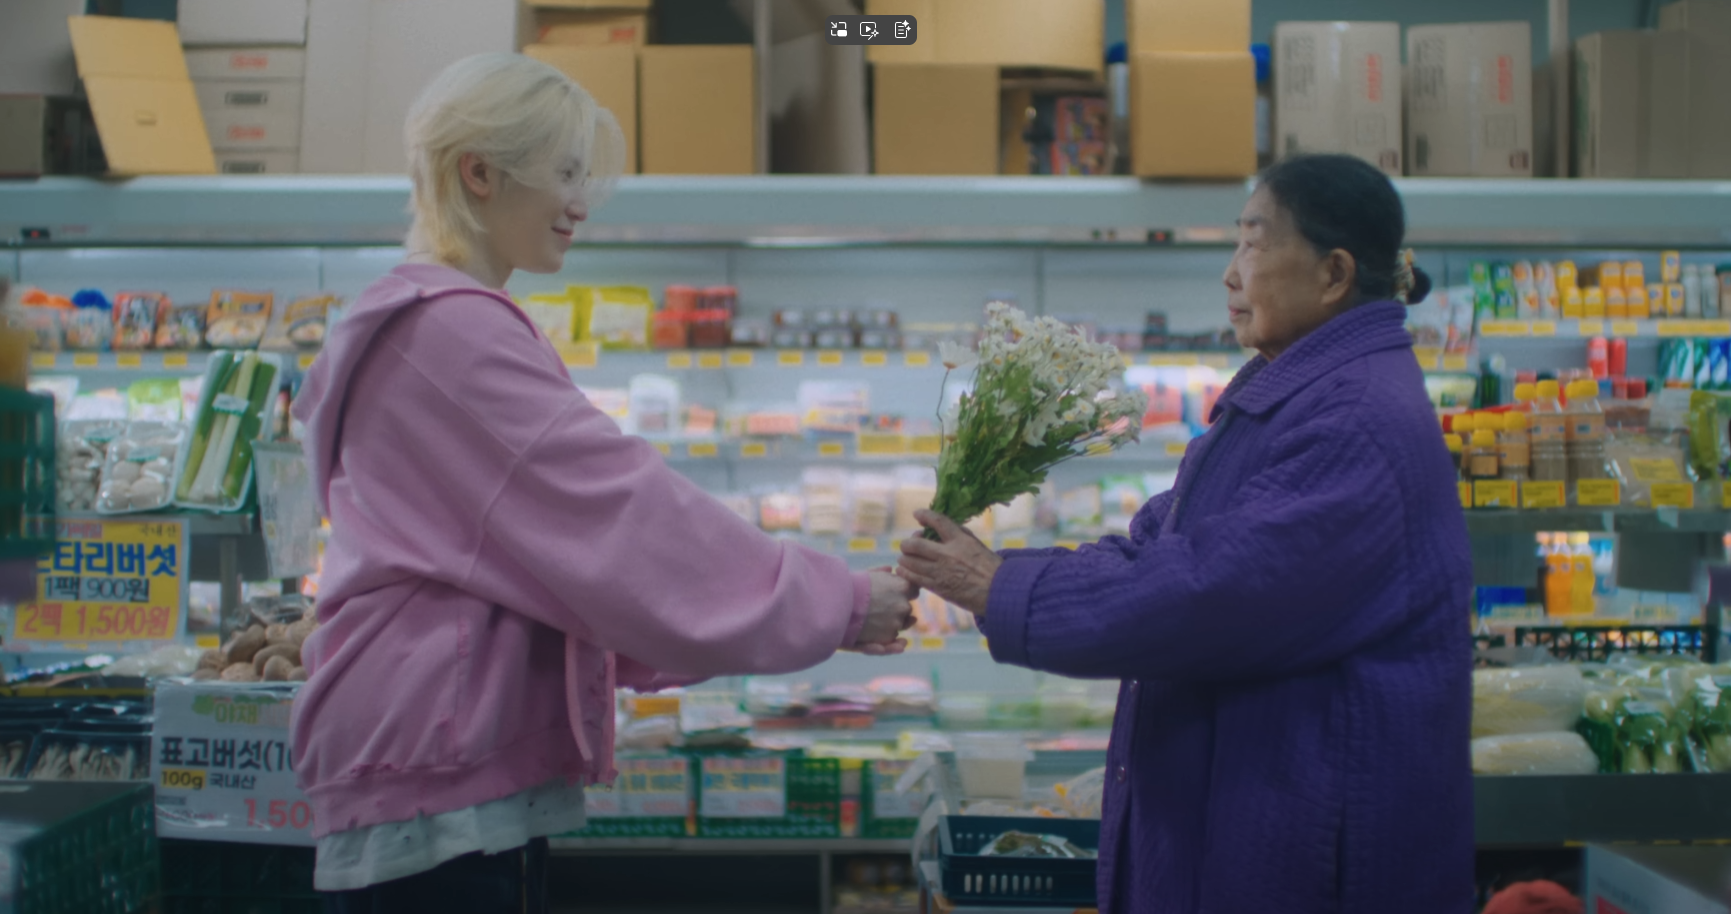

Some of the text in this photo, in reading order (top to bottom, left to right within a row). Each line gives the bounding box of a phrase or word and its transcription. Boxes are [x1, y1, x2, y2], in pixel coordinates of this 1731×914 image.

[45, 576, 150, 603] 1팩 900원
[23, 603, 171, 638] 2팩 1,500원
[214, 702, 258, 725] 야채
[160, 736, 293, 772] 표고버섯(1
[161, 771, 204, 791] 100g
[209, 772, 257, 790] 국내산
[243, 797, 313, 829] 1,50
